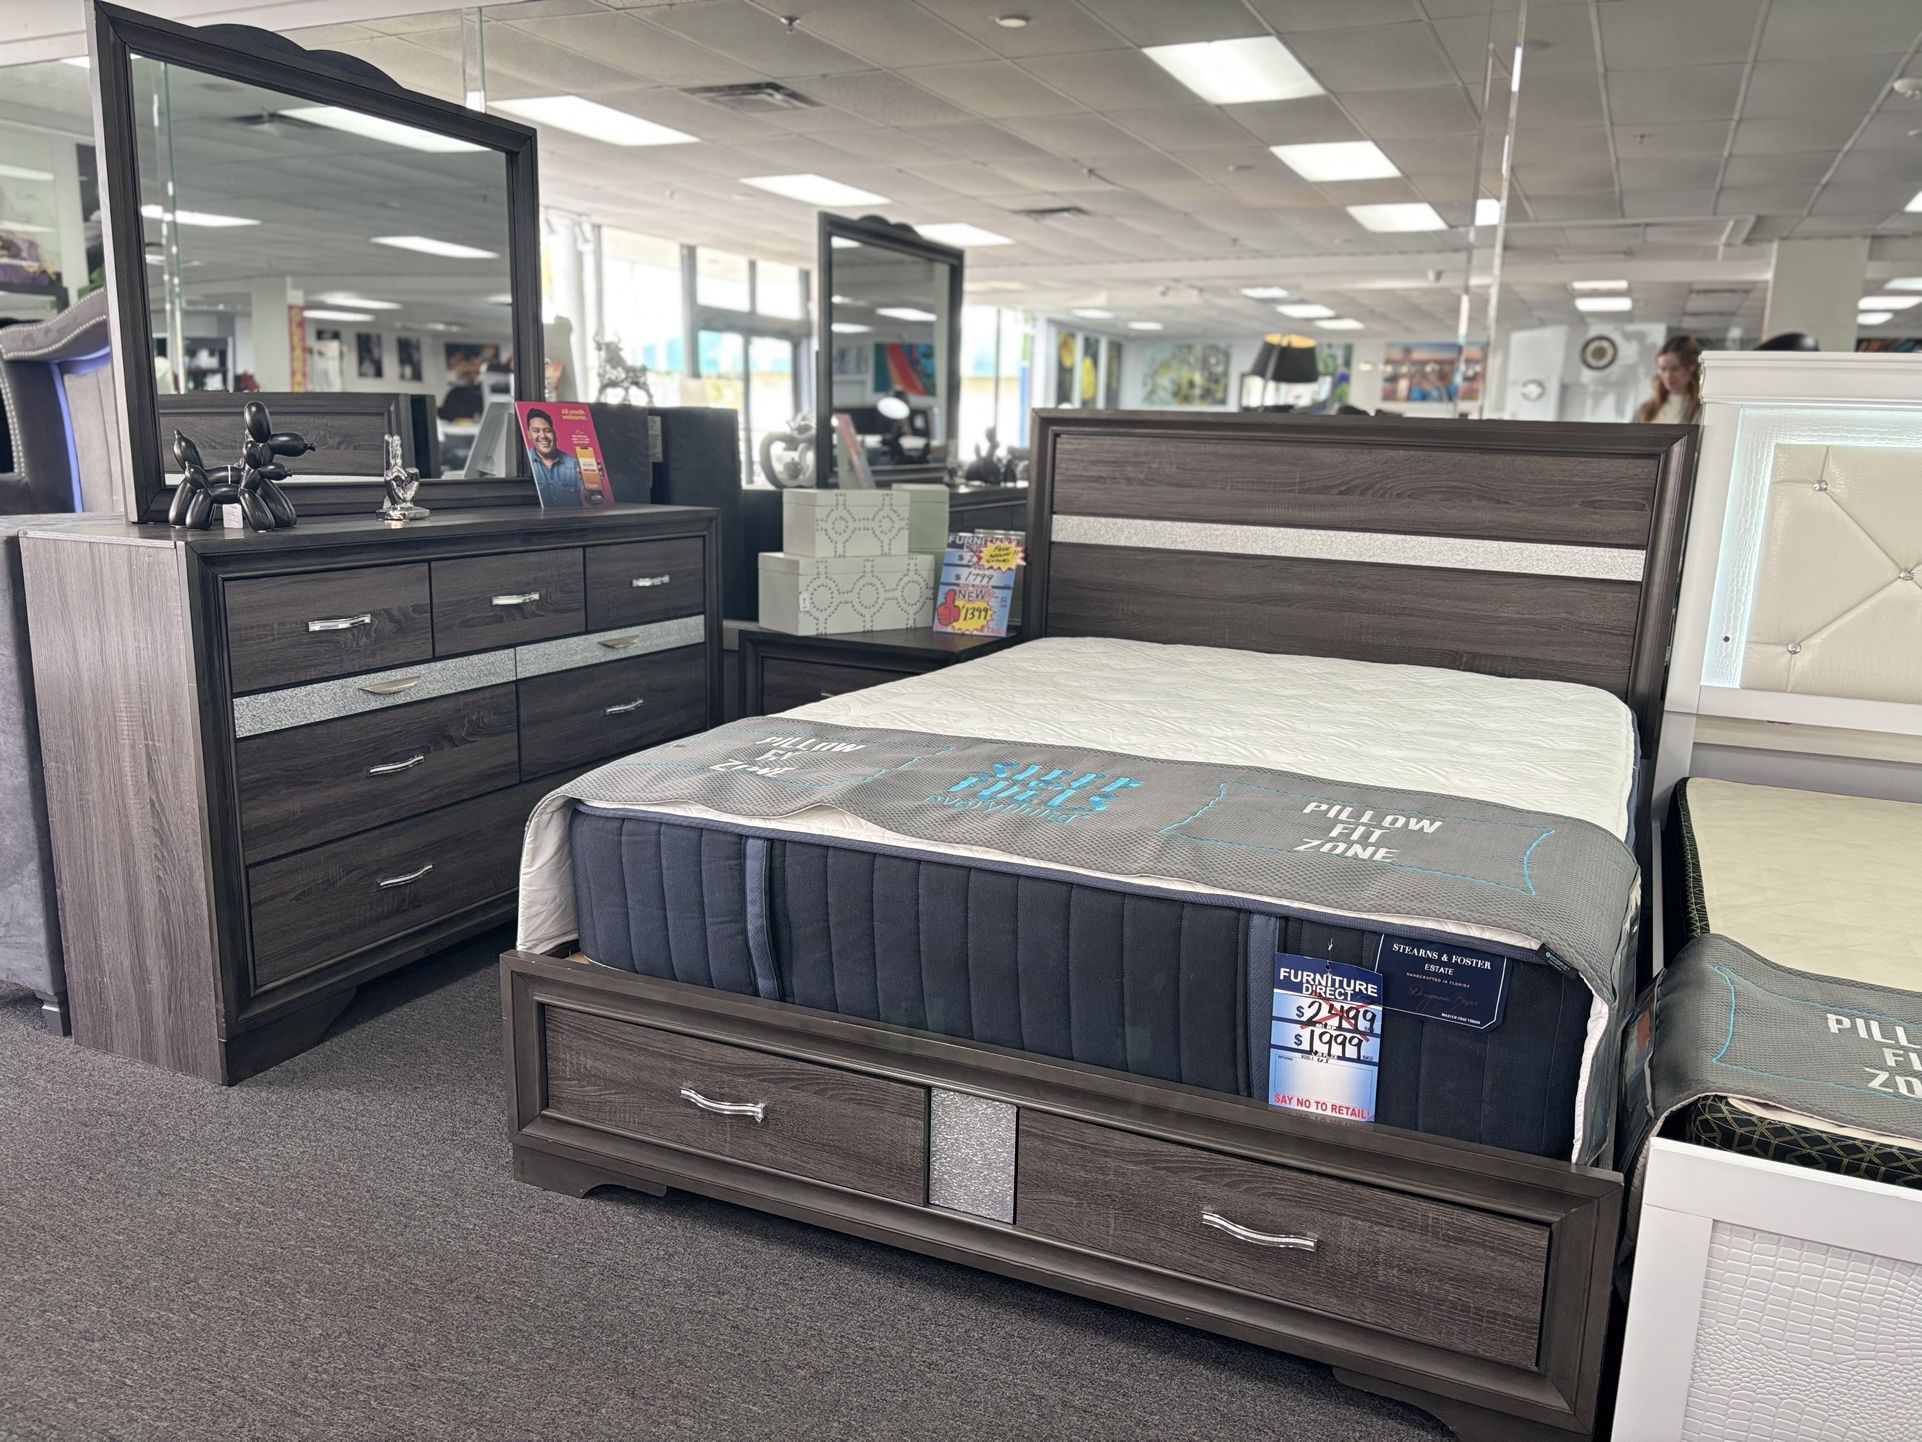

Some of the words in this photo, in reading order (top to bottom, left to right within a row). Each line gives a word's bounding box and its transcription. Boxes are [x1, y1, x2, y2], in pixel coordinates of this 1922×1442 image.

[1303, 801, 1443, 833] PILLOW
[1328, 823, 1391, 843] FIT
[1293, 838, 1399, 862] ZONE
[1392, 943, 1439, 960] STEARNS
[1441, 953, 1449, 962] &
[1451, 954, 1492, 970] FOSTER
[1280, 967, 1378, 997] FURNITURE
[1424, 963, 1455, 976] ESTATE
[1302, 984, 1354, 1001] DIRECT
[1274, 1093, 1293, 1104] SAY
[1296, 1097, 1311, 1108] NO
[1314, 1101, 1328, 1112] TO
[1330, 1104, 1371, 1119] RETAIL!
